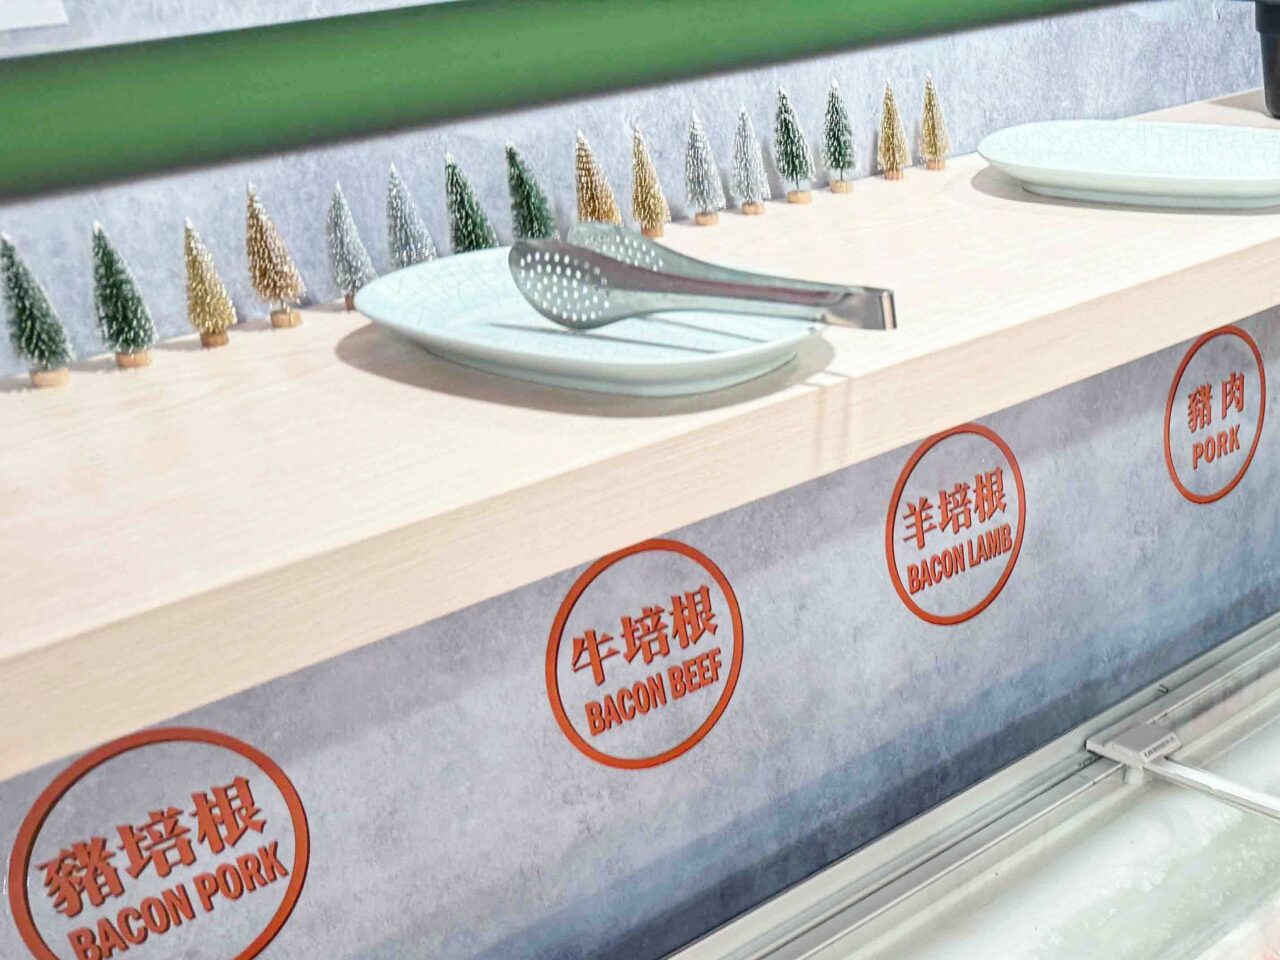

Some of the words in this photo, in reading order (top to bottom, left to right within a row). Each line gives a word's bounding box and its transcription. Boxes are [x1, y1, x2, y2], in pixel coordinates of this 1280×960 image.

[1187, 371, 1245, 434] 豬肉
[1192, 423, 1241, 471] PORK
[902, 466, 1008, 551] 羊培根
[907, 542, 966, 596] BACON
[967, 523, 1013, 569] LAMB
[571, 584, 718, 687] 牛培根
[585, 672, 668, 737] BACON
[667, 646, 722, 701] BEEF
[36, 776, 267, 919] 豬培根
[192, 841, 289, 913] PORK
